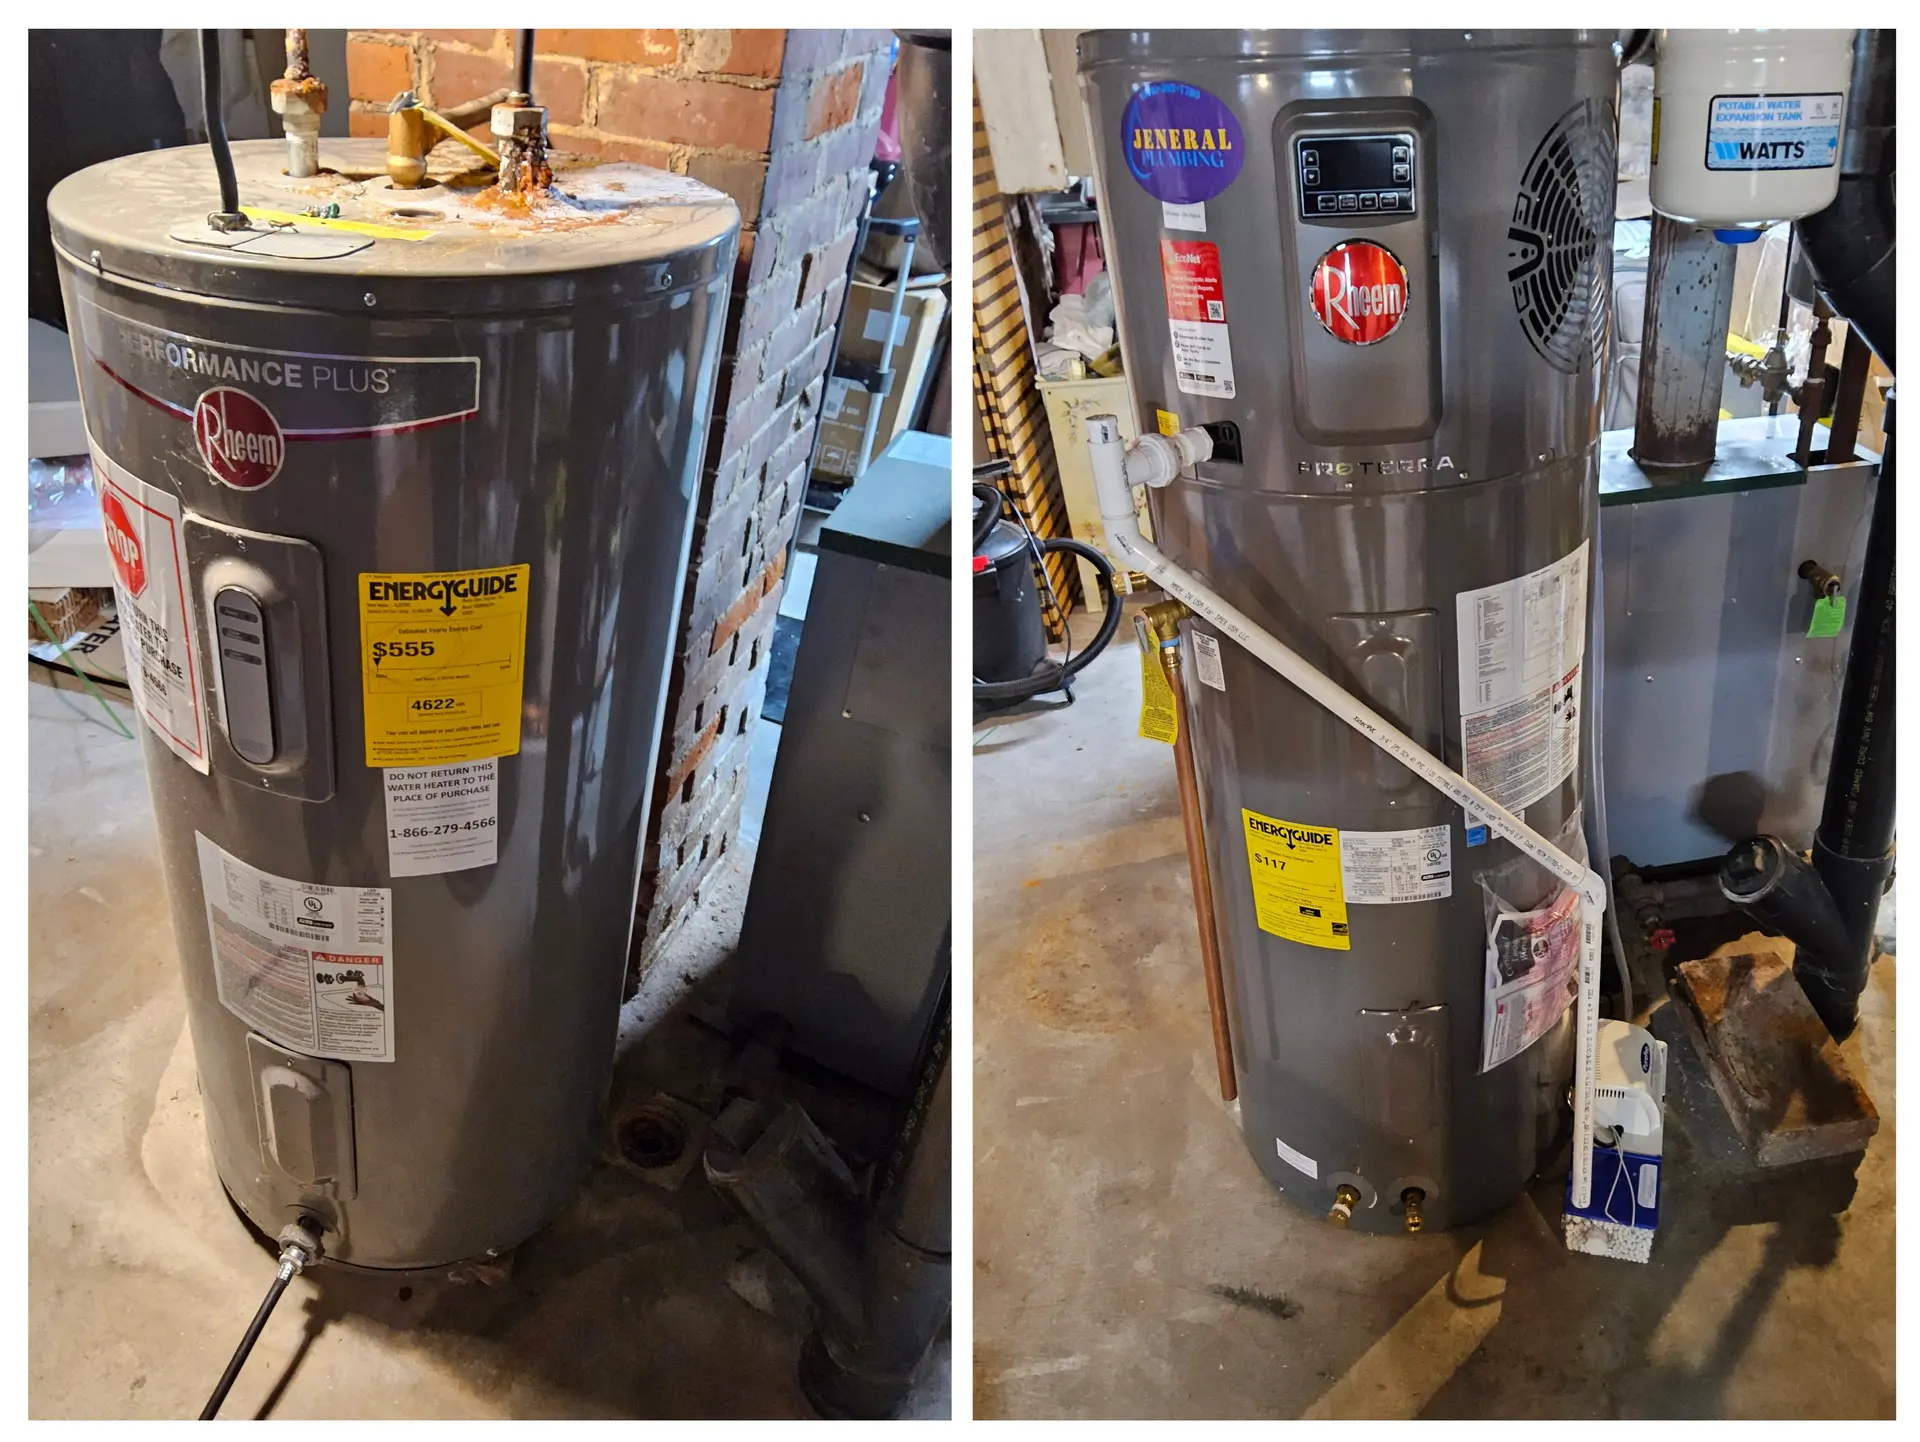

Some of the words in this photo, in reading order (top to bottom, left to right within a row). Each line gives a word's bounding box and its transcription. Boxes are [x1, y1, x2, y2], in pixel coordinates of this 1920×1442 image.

[1718, 100, 1762, 110] POTABLE
[1767, 100, 1801, 109] WATER
[1715, 112, 1774, 122] EXPANSION
[1777, 111, 1803, 121] TANK
[1133, 128, 1232, 150] JENERAL
[1141, 150, 1225, 168] PLUMBING
[1739, 141, 1805, 160] WATTS
[1322, 252, 1401, 330] Rheem
[201, 391, 278, 472] Rheem
[1298, 455, 1455, 476] PROTERRA
[369, 573, 518, 602] ENERGYGUIDE
[373, 641, 435, 658] $555
[411, 698, 455, 711] 4622
[389, 773, 405, 781] DO
[407, 771, 428, 780] NOT
[430, 767, 470, 778] RETURN
[471, 762, 493, 772] THIS
[387, 783, 421, 792] WATER
[423, 779, 461, 790] HEATER
[463, 776, 475, 785] TO
[477, 772, 496, 782] THE
[393, 793, 423, 802] PLACE
[425, 792, 438, 800] OF
[440, 785, 490, 799] PURCHASE
[390, 816, 496, 839] 1-866-279-4566
[1249, 817, 1333, 846] ENERGYGUIDE
[328, 955, 380, 964] DANGER
